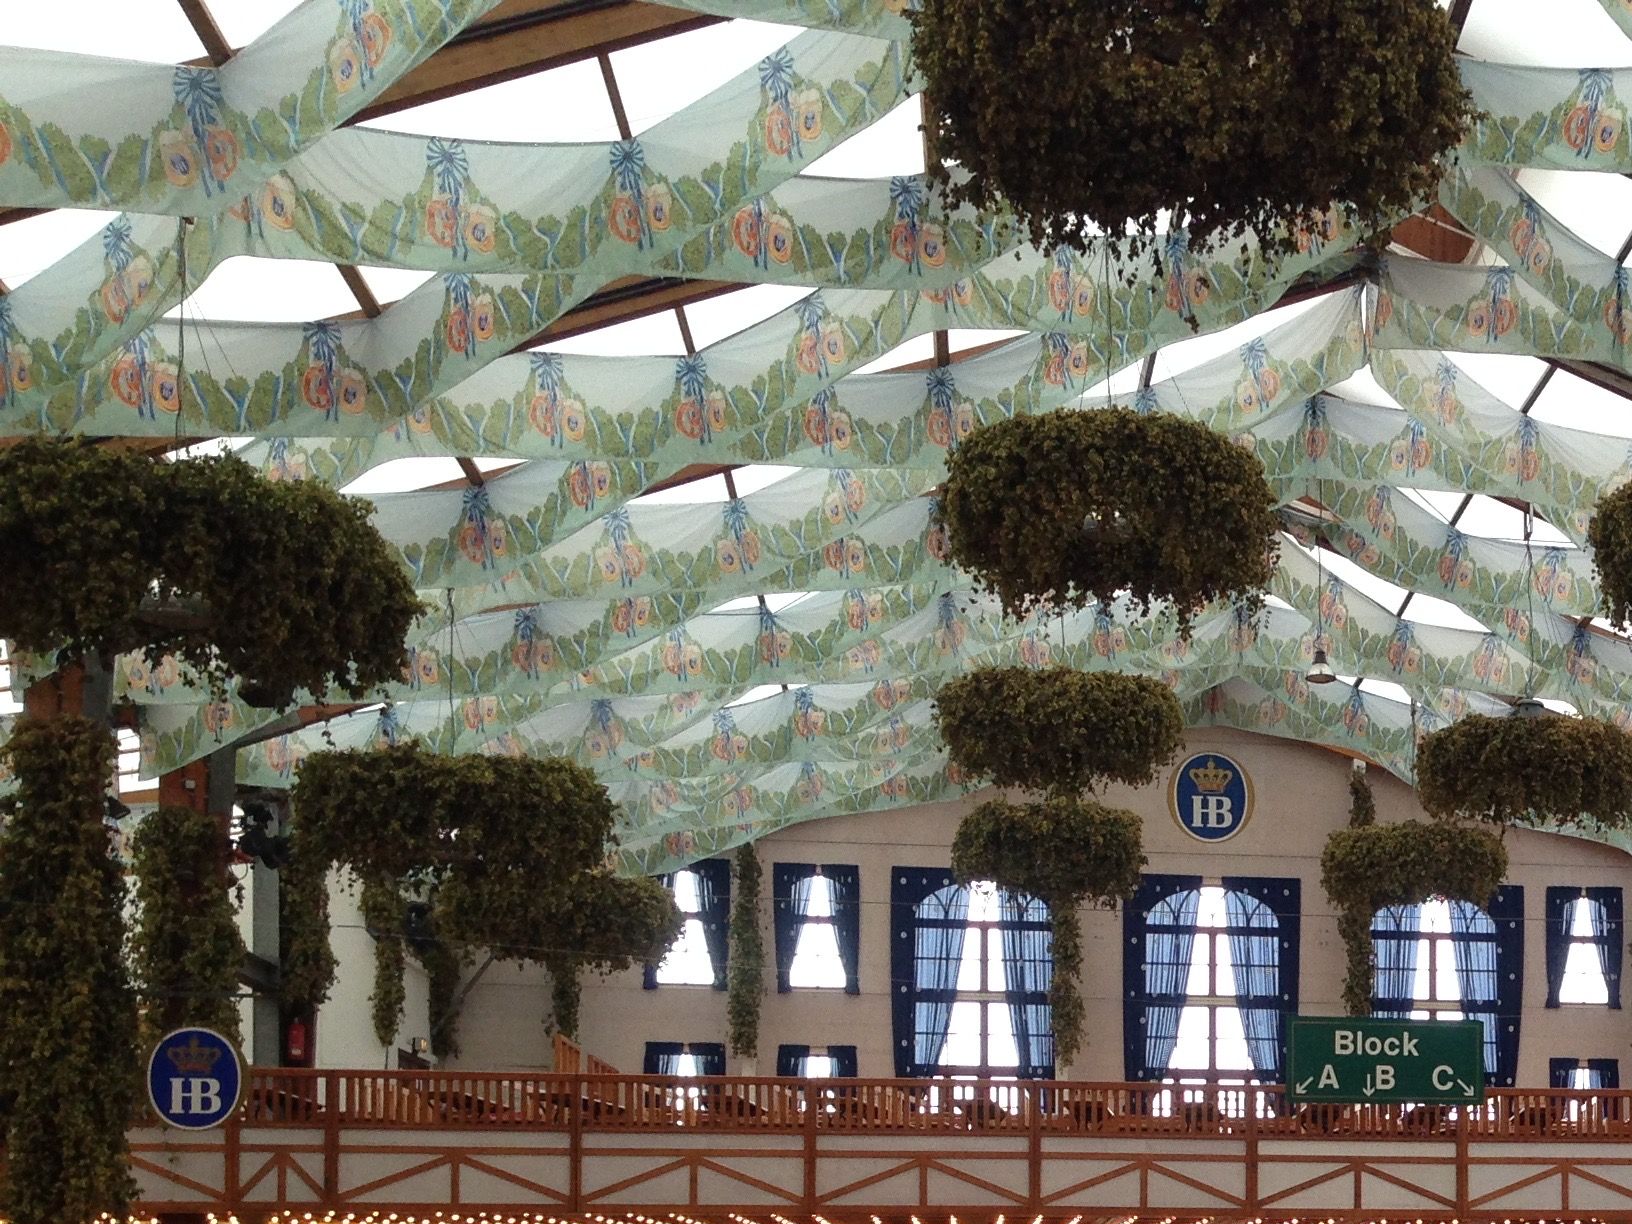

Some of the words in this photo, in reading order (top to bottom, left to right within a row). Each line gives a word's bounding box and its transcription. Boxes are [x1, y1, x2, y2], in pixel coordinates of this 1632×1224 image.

[1191, 795, 1233, 828] HB
[1334, 1030, 1420, 1057] Block
[1318, 1064, 1340, 1089] A
[1375, 1064, 1396, 1090] B
[1432, 1064, 1455, 1091] C
[169, 1077, 222, 1114] HB
